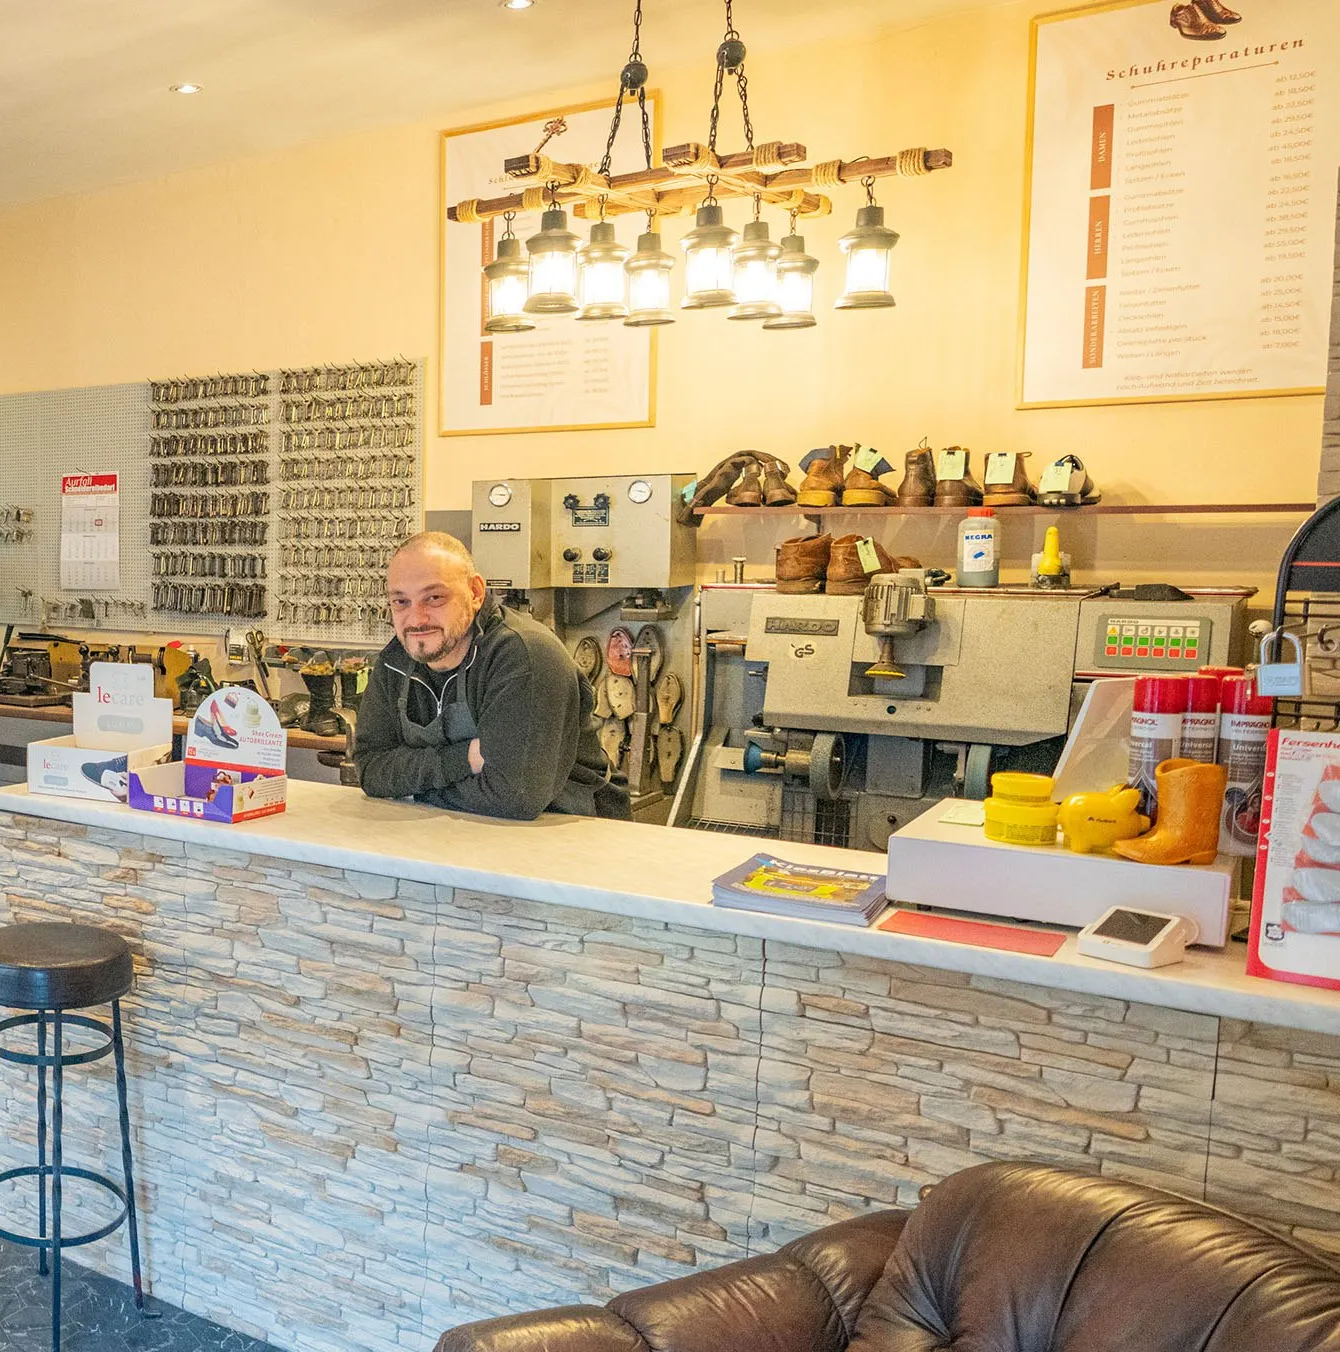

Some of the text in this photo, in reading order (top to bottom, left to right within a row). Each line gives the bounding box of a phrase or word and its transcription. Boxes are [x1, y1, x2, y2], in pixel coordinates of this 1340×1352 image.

[1105, 38, 1305, 81] Schuhreparaturen
[1098, 131, 1107, 163] DAMEN
[1093, 220, 1103, 256] HERREN
[1090, 290, 1100, 365] SONDERARBEITEN
[480, 523, 520, 531] HARDO
[765, 618, 837, 633] HARDO
